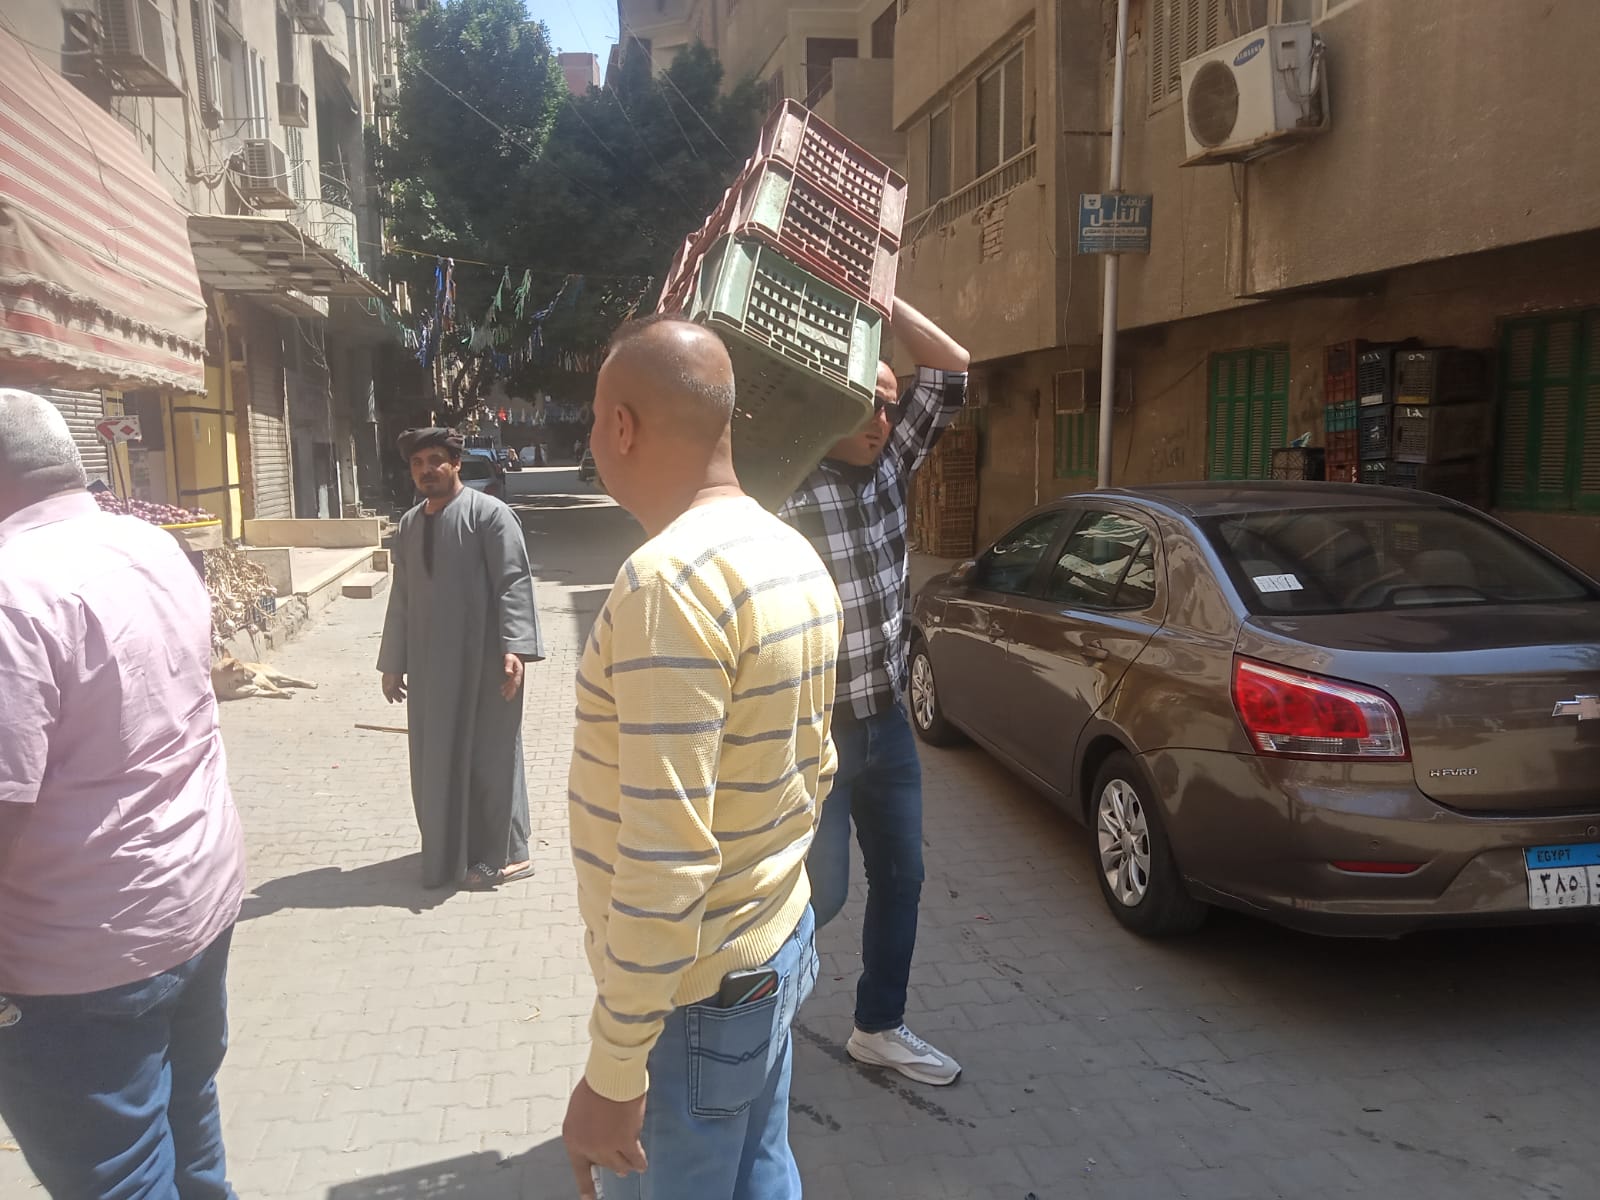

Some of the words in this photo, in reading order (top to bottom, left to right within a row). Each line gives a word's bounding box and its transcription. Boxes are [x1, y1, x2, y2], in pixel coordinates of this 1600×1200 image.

[1090, 207, 1140, 227] النيل
[1536, 848, 1571, 863] EGYPT
[1540, 872, 1578, 896] ٣٨٥
